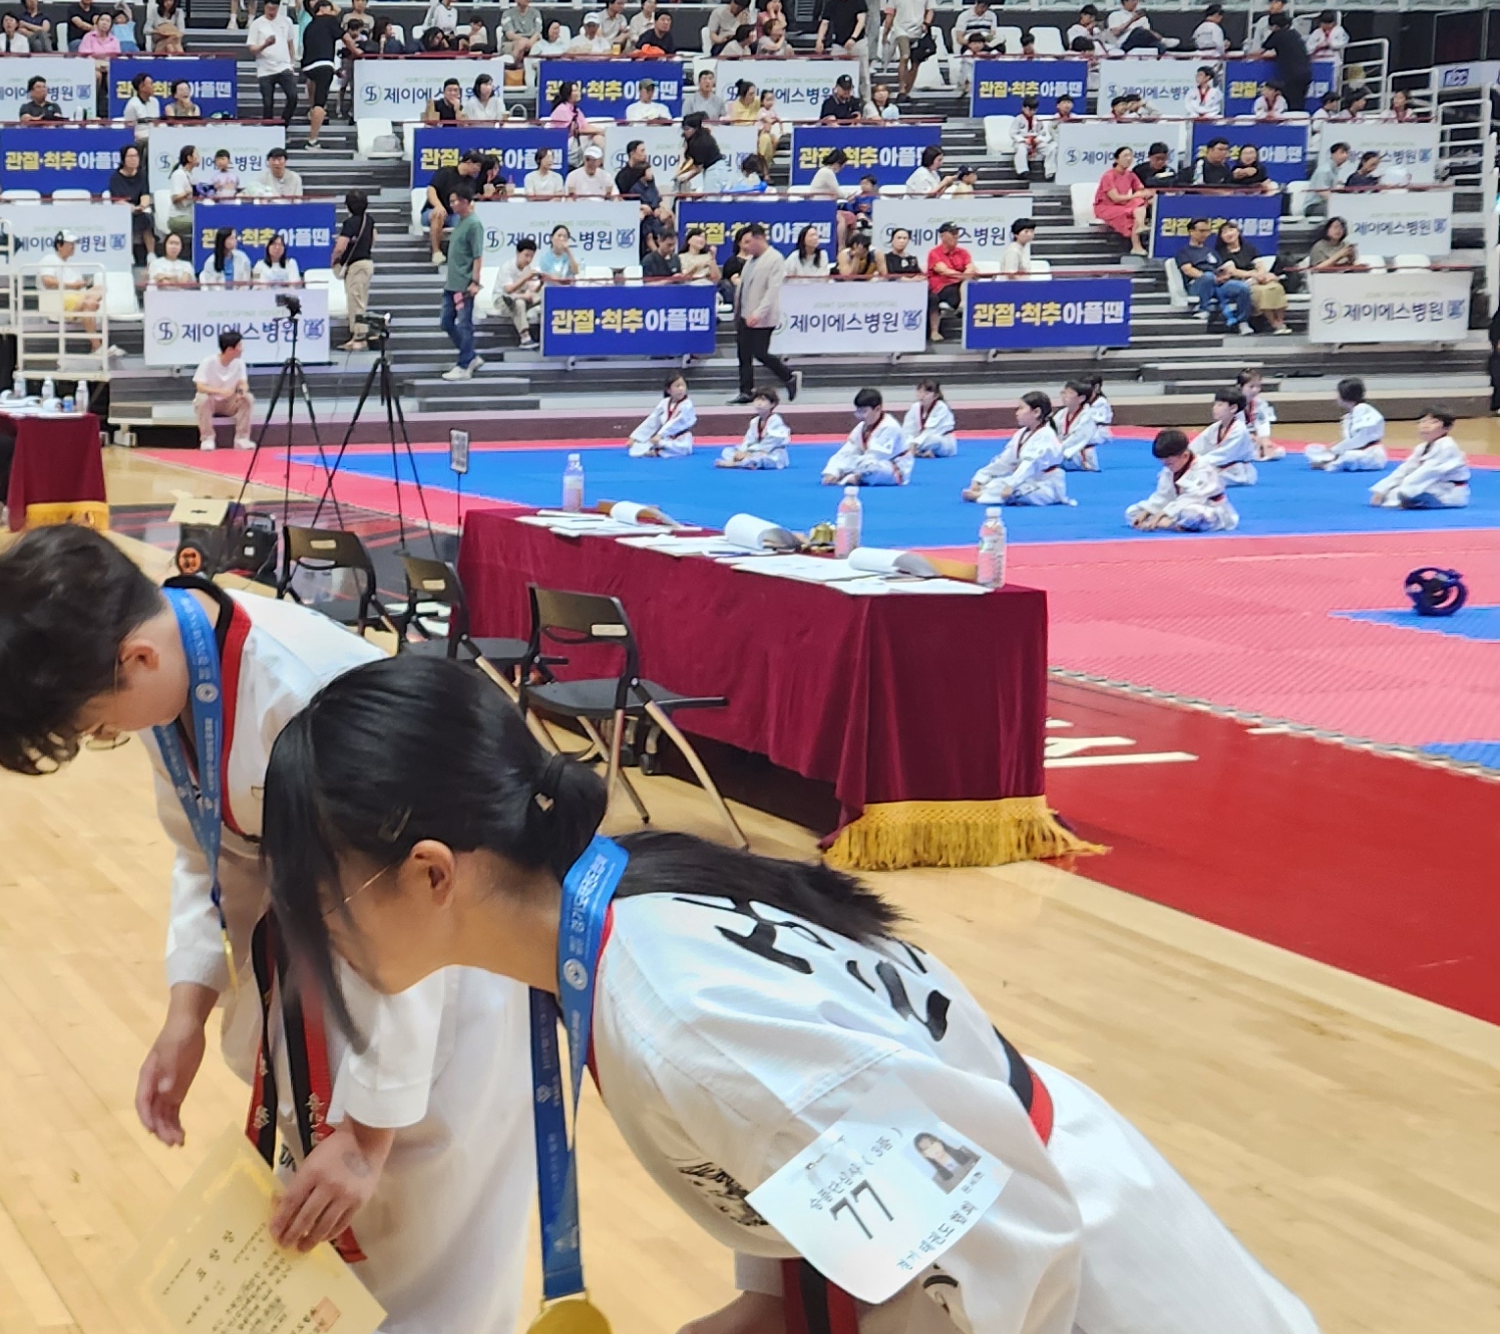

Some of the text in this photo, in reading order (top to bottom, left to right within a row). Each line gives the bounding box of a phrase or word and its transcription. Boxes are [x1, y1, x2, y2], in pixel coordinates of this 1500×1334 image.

[979, 80, 1083, 98] 관절·척추 아플땐
[5, 150, 77, 170] 관절·척추
[800, 146, 878, 169] 관척추
[202, 227, 330, 248] 관·척추 아플땐
[909, 226, 1006, 246] 제이스병원
[1353, 220, 1431, 236] 제이에스병원
[20, 235, 106, 253] 이병원
[551, 308, 710, 334] 관절·척추 아플땐
[973, 301, 1125, 327] 관절·척추 아플땐
[1344, 301, 1443, 322] 제이에스병원
[790, 312, 899, 334] 제이에스병원
[829, 1179, 895, 1240] 77
